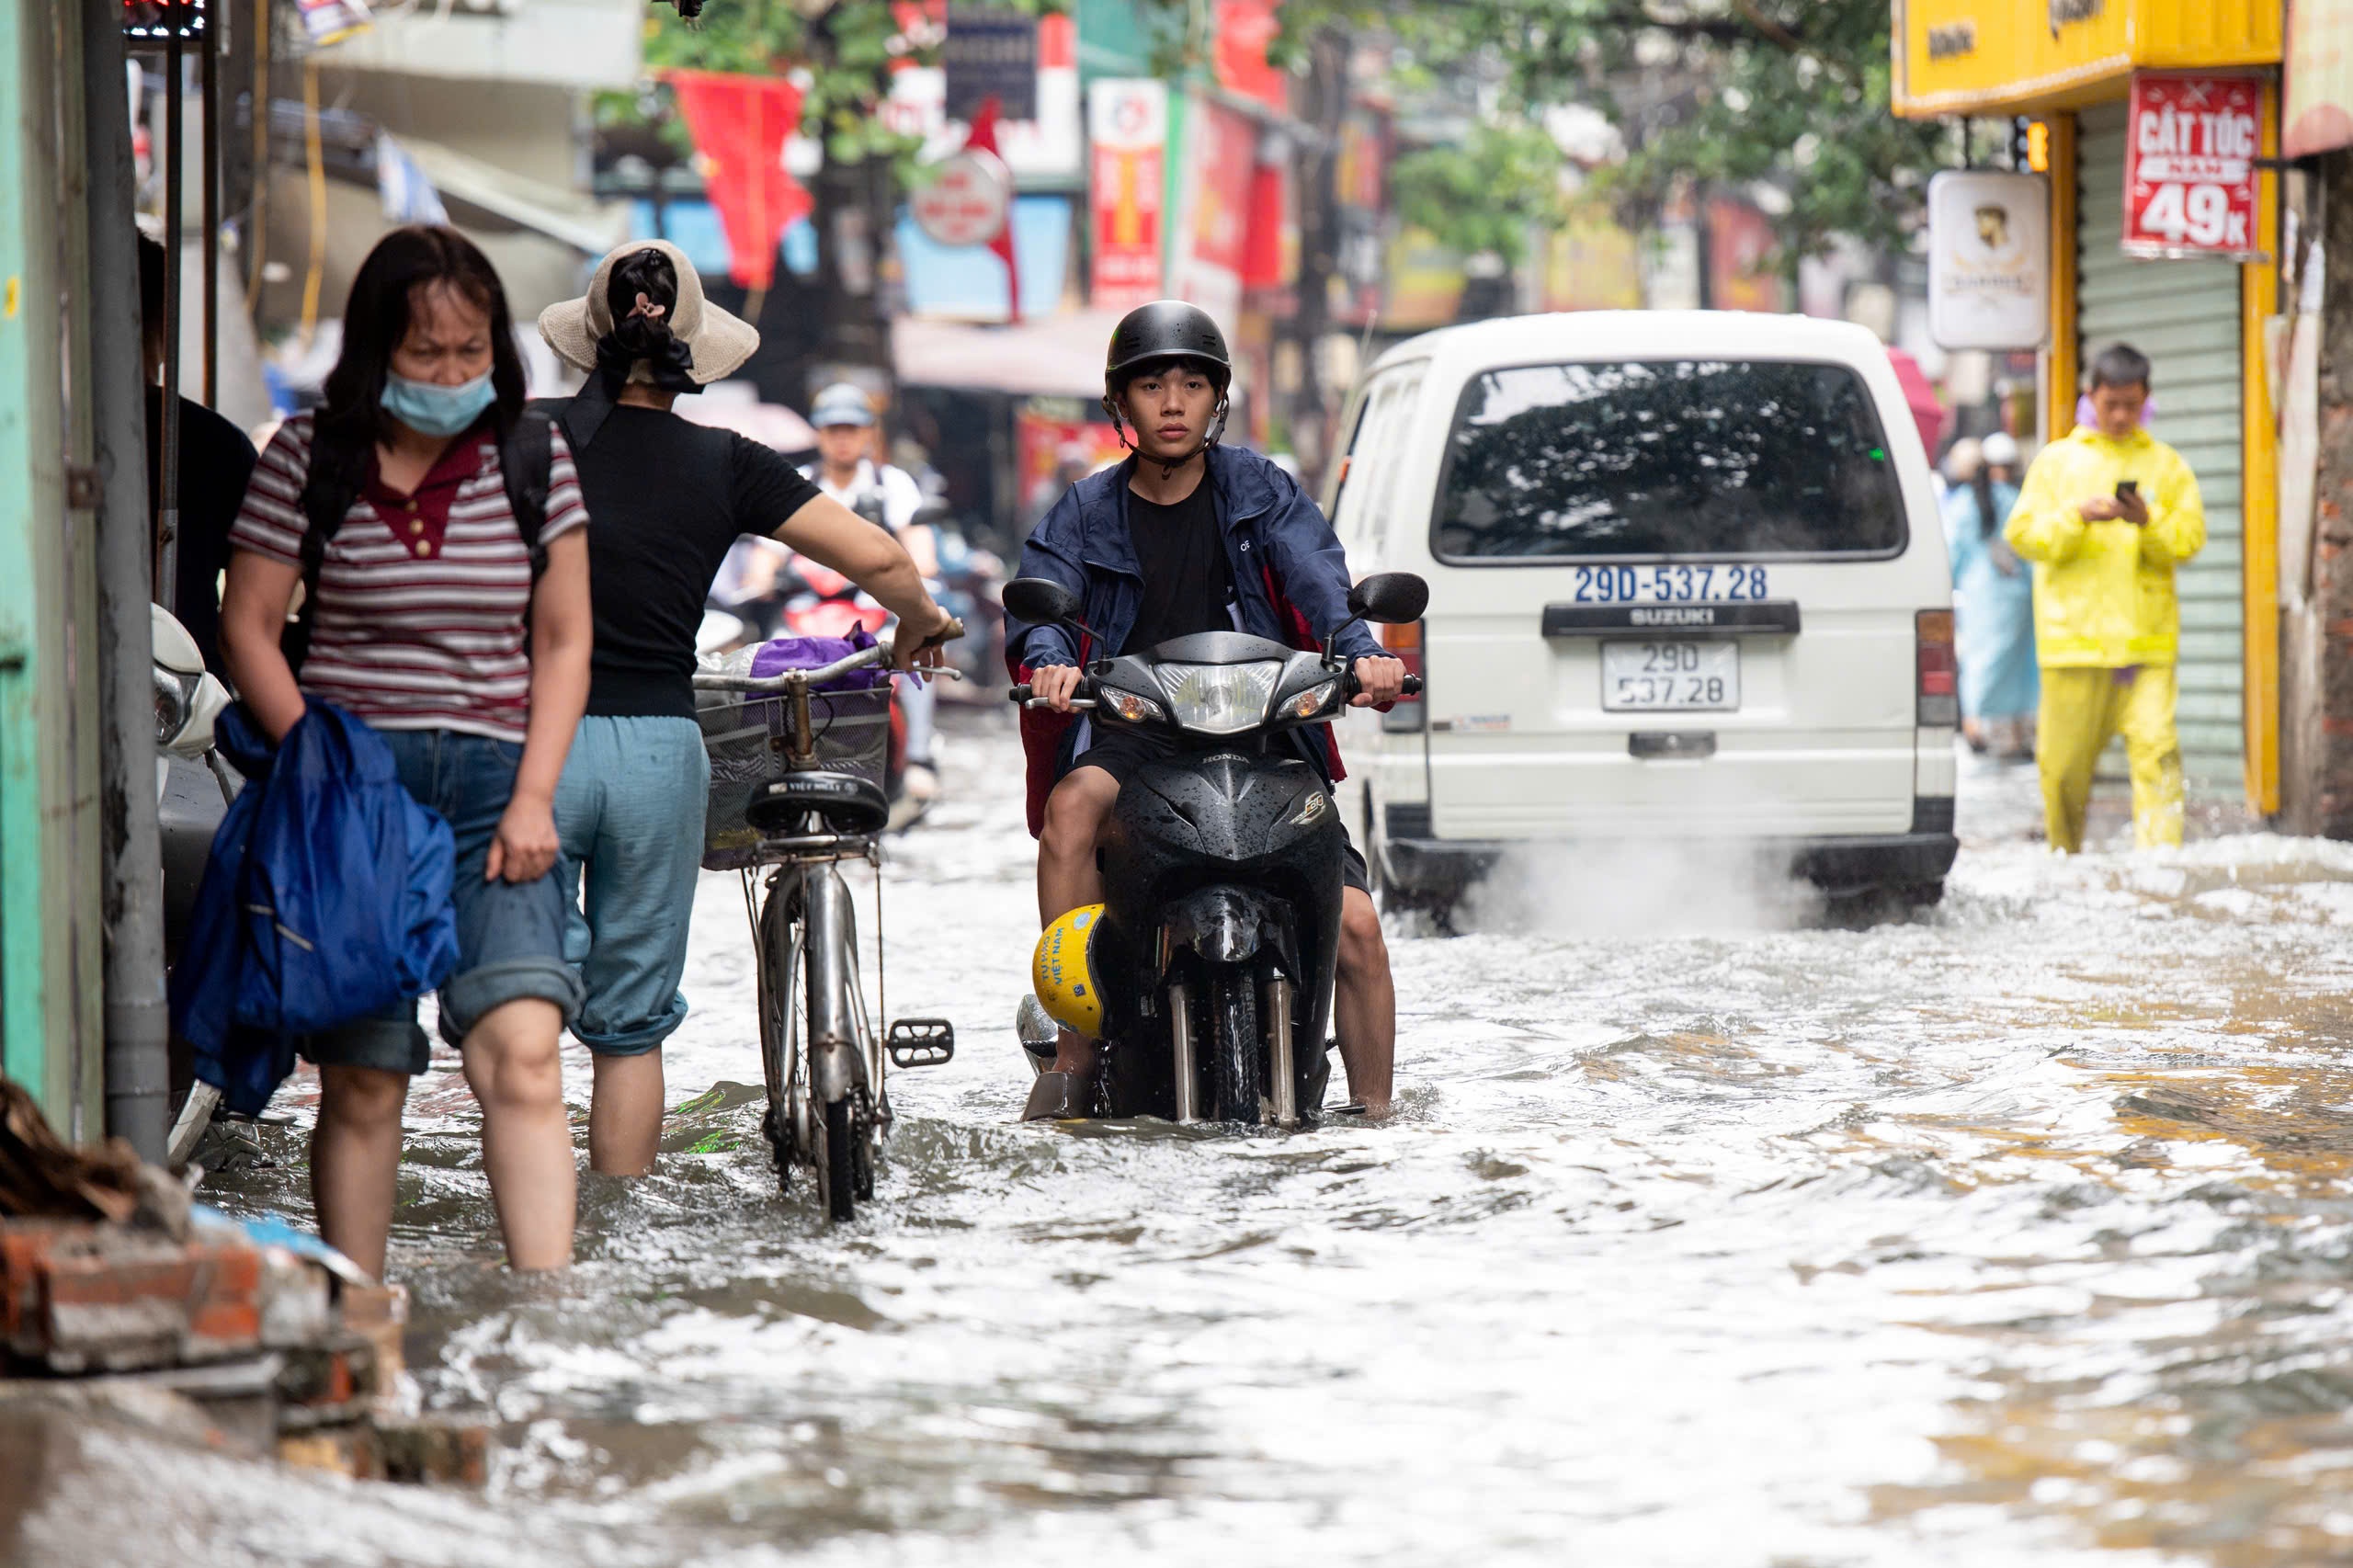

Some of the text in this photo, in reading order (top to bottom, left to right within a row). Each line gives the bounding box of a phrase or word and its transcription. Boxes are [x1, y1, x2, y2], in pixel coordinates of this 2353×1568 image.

[1575, 566, 1767, 602] 29D-537.28
[1630, 608, 1714, 625] SUZUKI
[1643, 643, 1699, 672] 29D
[1203, 754, 1250, 764] HONDA
[1052, 927, 1064, 954] NAM
